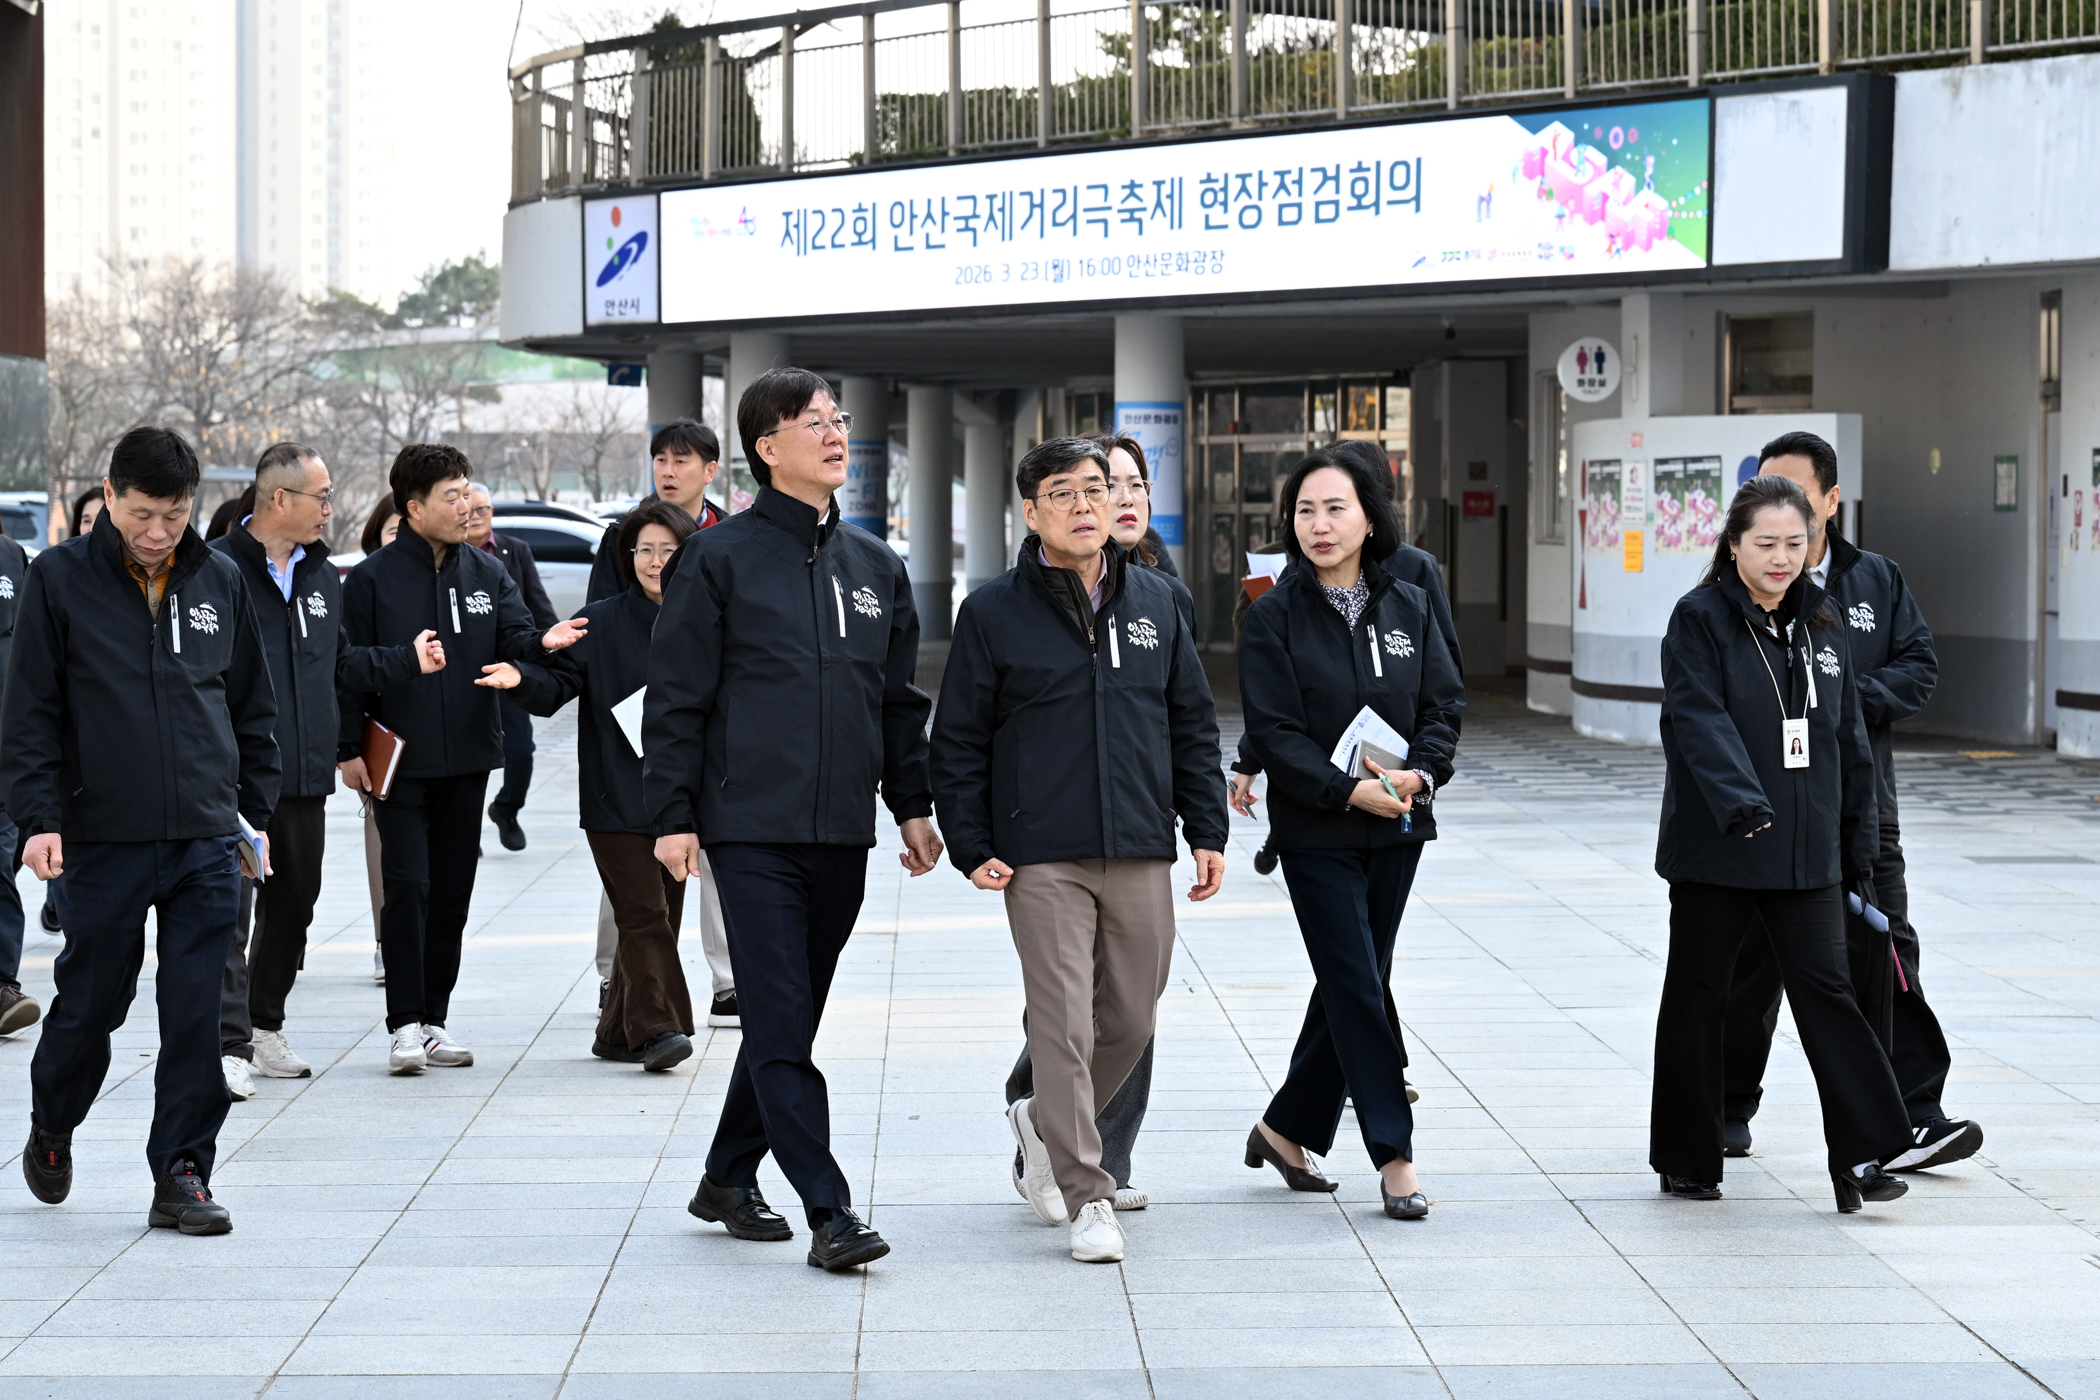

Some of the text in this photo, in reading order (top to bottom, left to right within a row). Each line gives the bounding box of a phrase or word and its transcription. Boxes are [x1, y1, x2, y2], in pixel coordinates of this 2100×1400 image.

[781, 157, 1422, 257] 제22회 안산국제거리극축제 현장점검회의
[955, 265, 996, 285] 2026.
[1002, 263, 1015, 283] 3.
[1079, 256, 1121, 277] 16:00
[1126, 249, 1225, 278] 안산문화광장
[605, 298, 640, 317] 안산시
